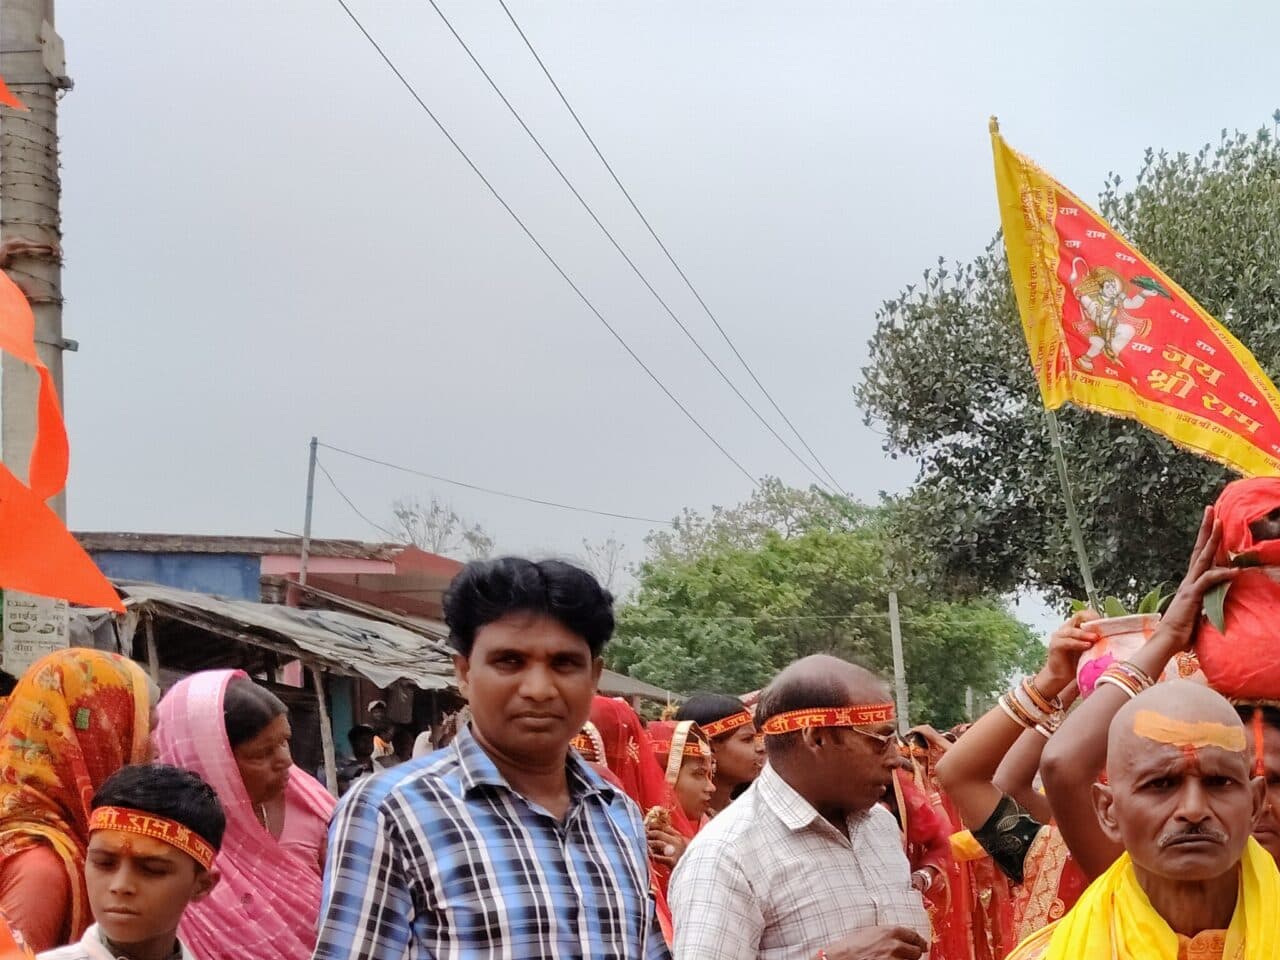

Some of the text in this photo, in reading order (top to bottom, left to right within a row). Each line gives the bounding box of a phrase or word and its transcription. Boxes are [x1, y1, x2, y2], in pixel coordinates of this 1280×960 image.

[1161, 344, 1226, 387] जय
[1147, 369, 1264, 434] श्री राम
[858, 710, 887, 722] जय
[127, 812, 171, 837] राम
